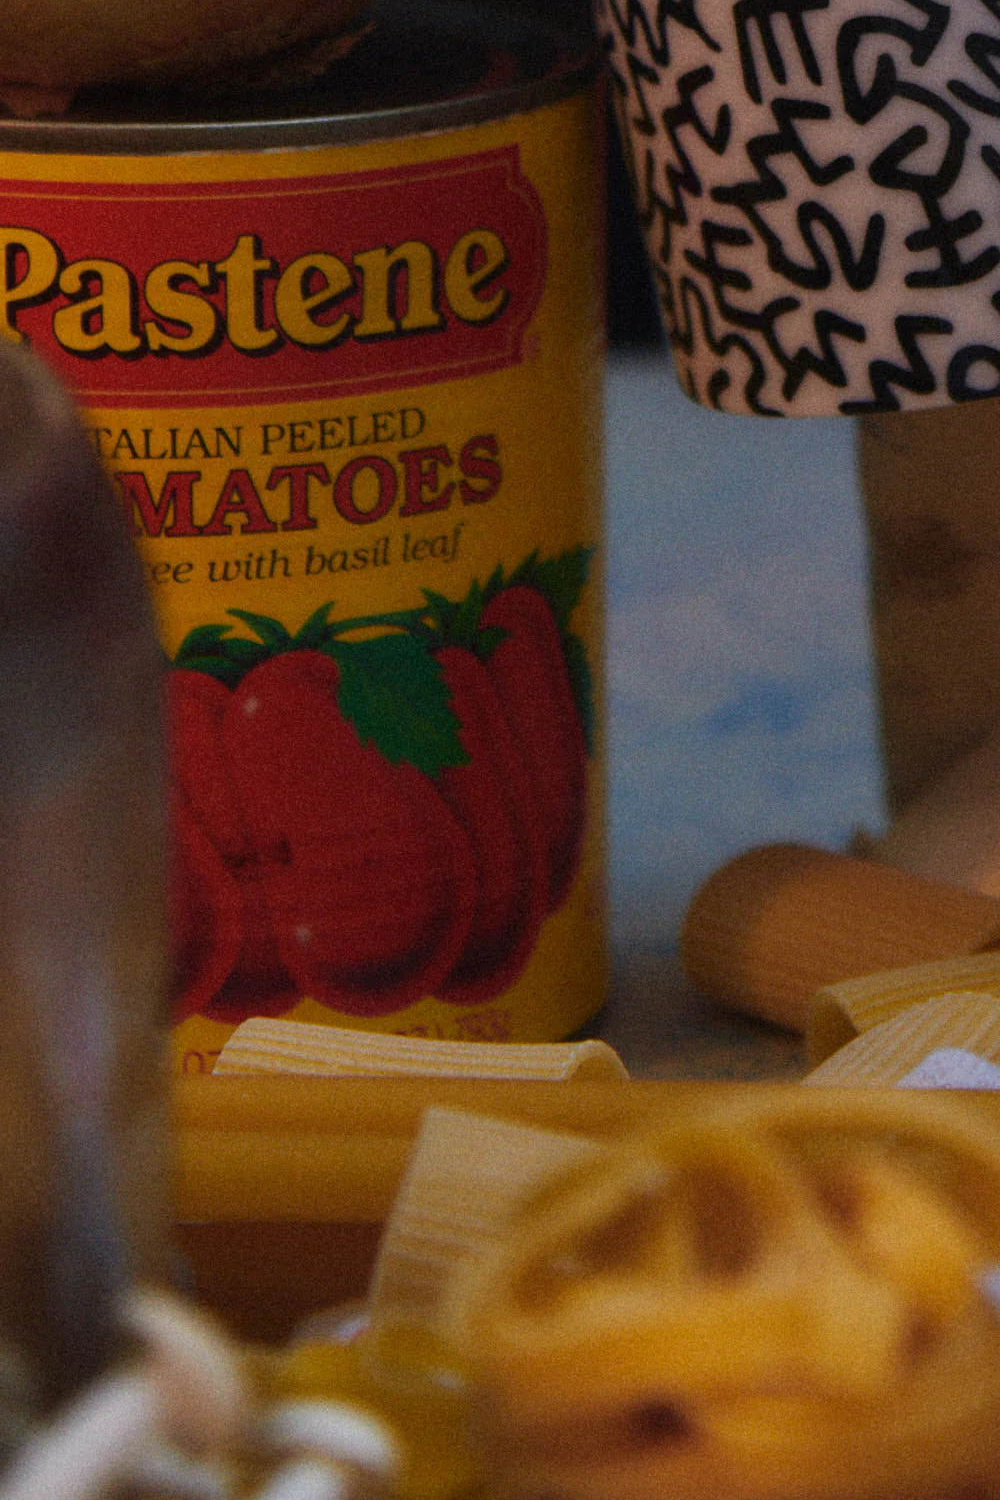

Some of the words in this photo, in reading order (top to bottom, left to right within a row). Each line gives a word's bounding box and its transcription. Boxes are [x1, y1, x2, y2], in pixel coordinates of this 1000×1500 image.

[0, 226, 513, 360] Pastene
[93, 423, 244, 461] TALIAN
[260, 407, 427, 456] PEELED
[113, 433, 503, 539] MATOES
[207, 548, 293, 584] with
[304, 535, 391, 577] basil
[401, 519, 467, 564] leaf
